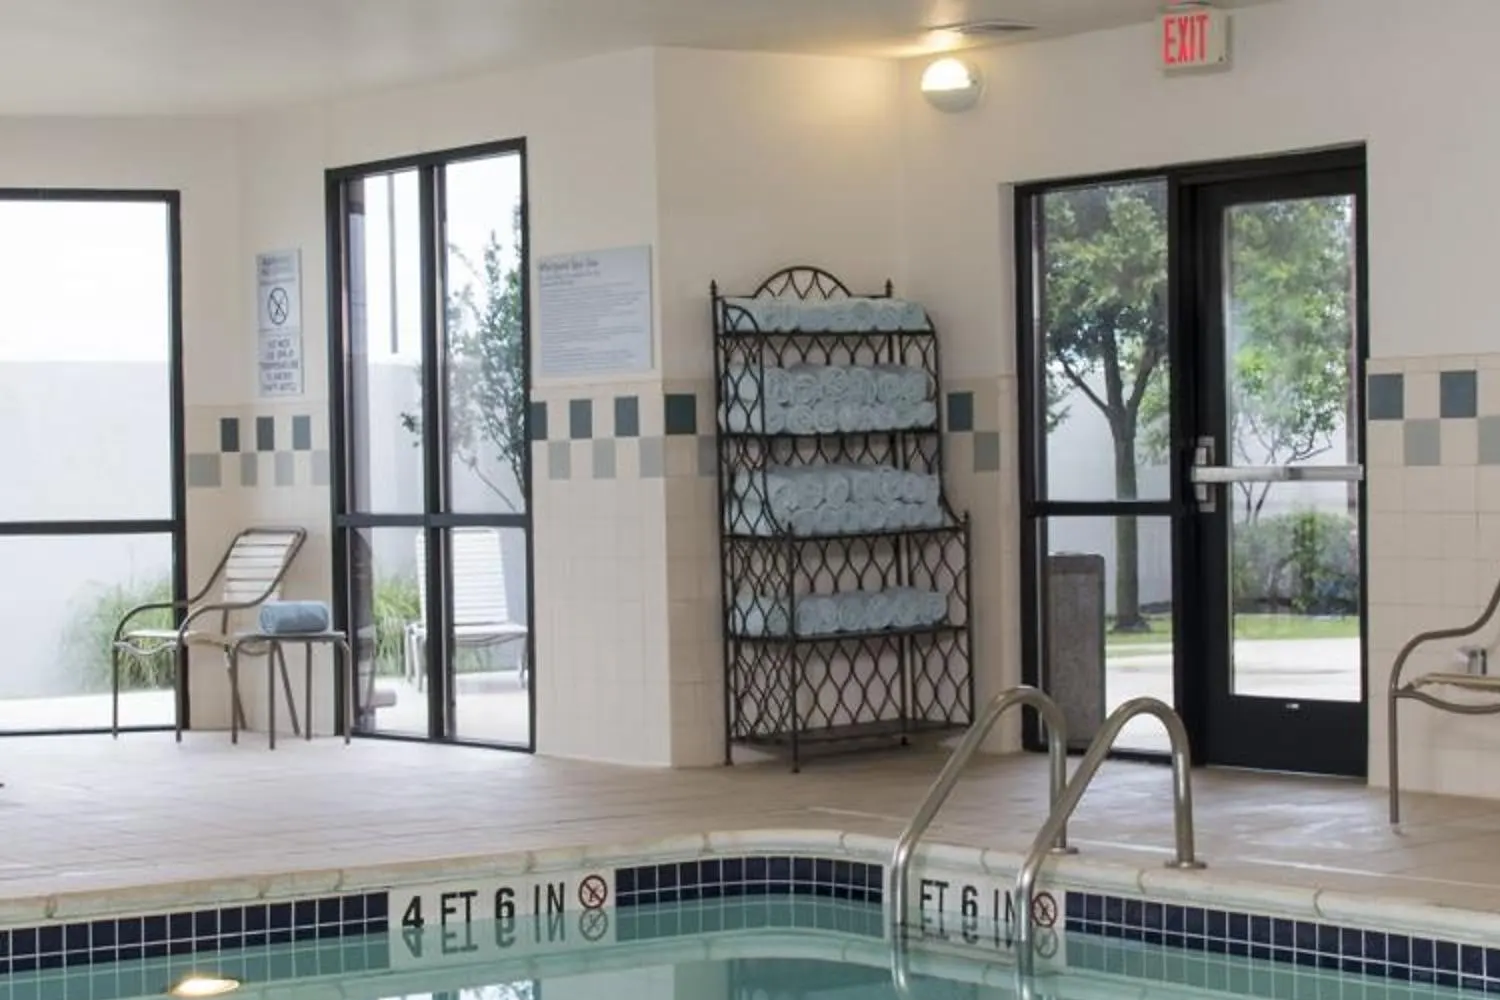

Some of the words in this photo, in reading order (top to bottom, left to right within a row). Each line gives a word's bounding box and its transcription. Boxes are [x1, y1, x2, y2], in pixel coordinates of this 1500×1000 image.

[1163, 14, 1209, 64] EXIT
[402, 896, 424, 928] 4
[441, 890, 478, 924] FT
[495, 887, 515, 919] 6
[535, 882, 565, 914] IN
[919, 879, 949, 913] FT
[961, 884, 979, 916] 6
